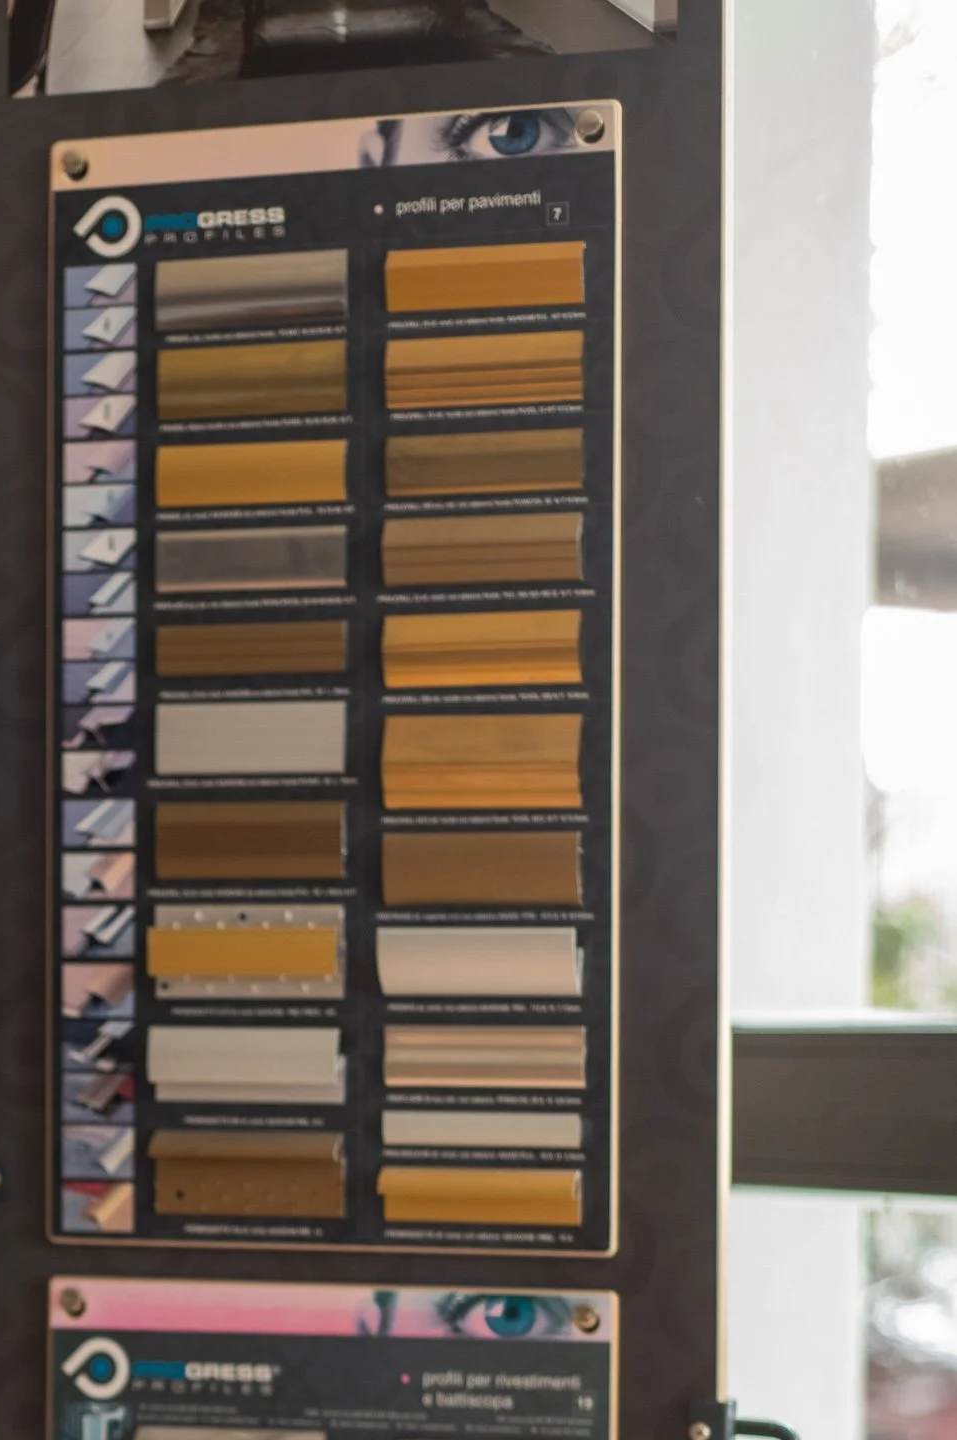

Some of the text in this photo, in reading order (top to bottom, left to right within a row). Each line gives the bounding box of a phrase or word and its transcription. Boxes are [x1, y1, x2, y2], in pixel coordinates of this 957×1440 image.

[395, 188, 542, 218] profili per pavimenti
[144, 206, 285, 232] GRESS
[132, 1361, 272, 1383] GRESS
